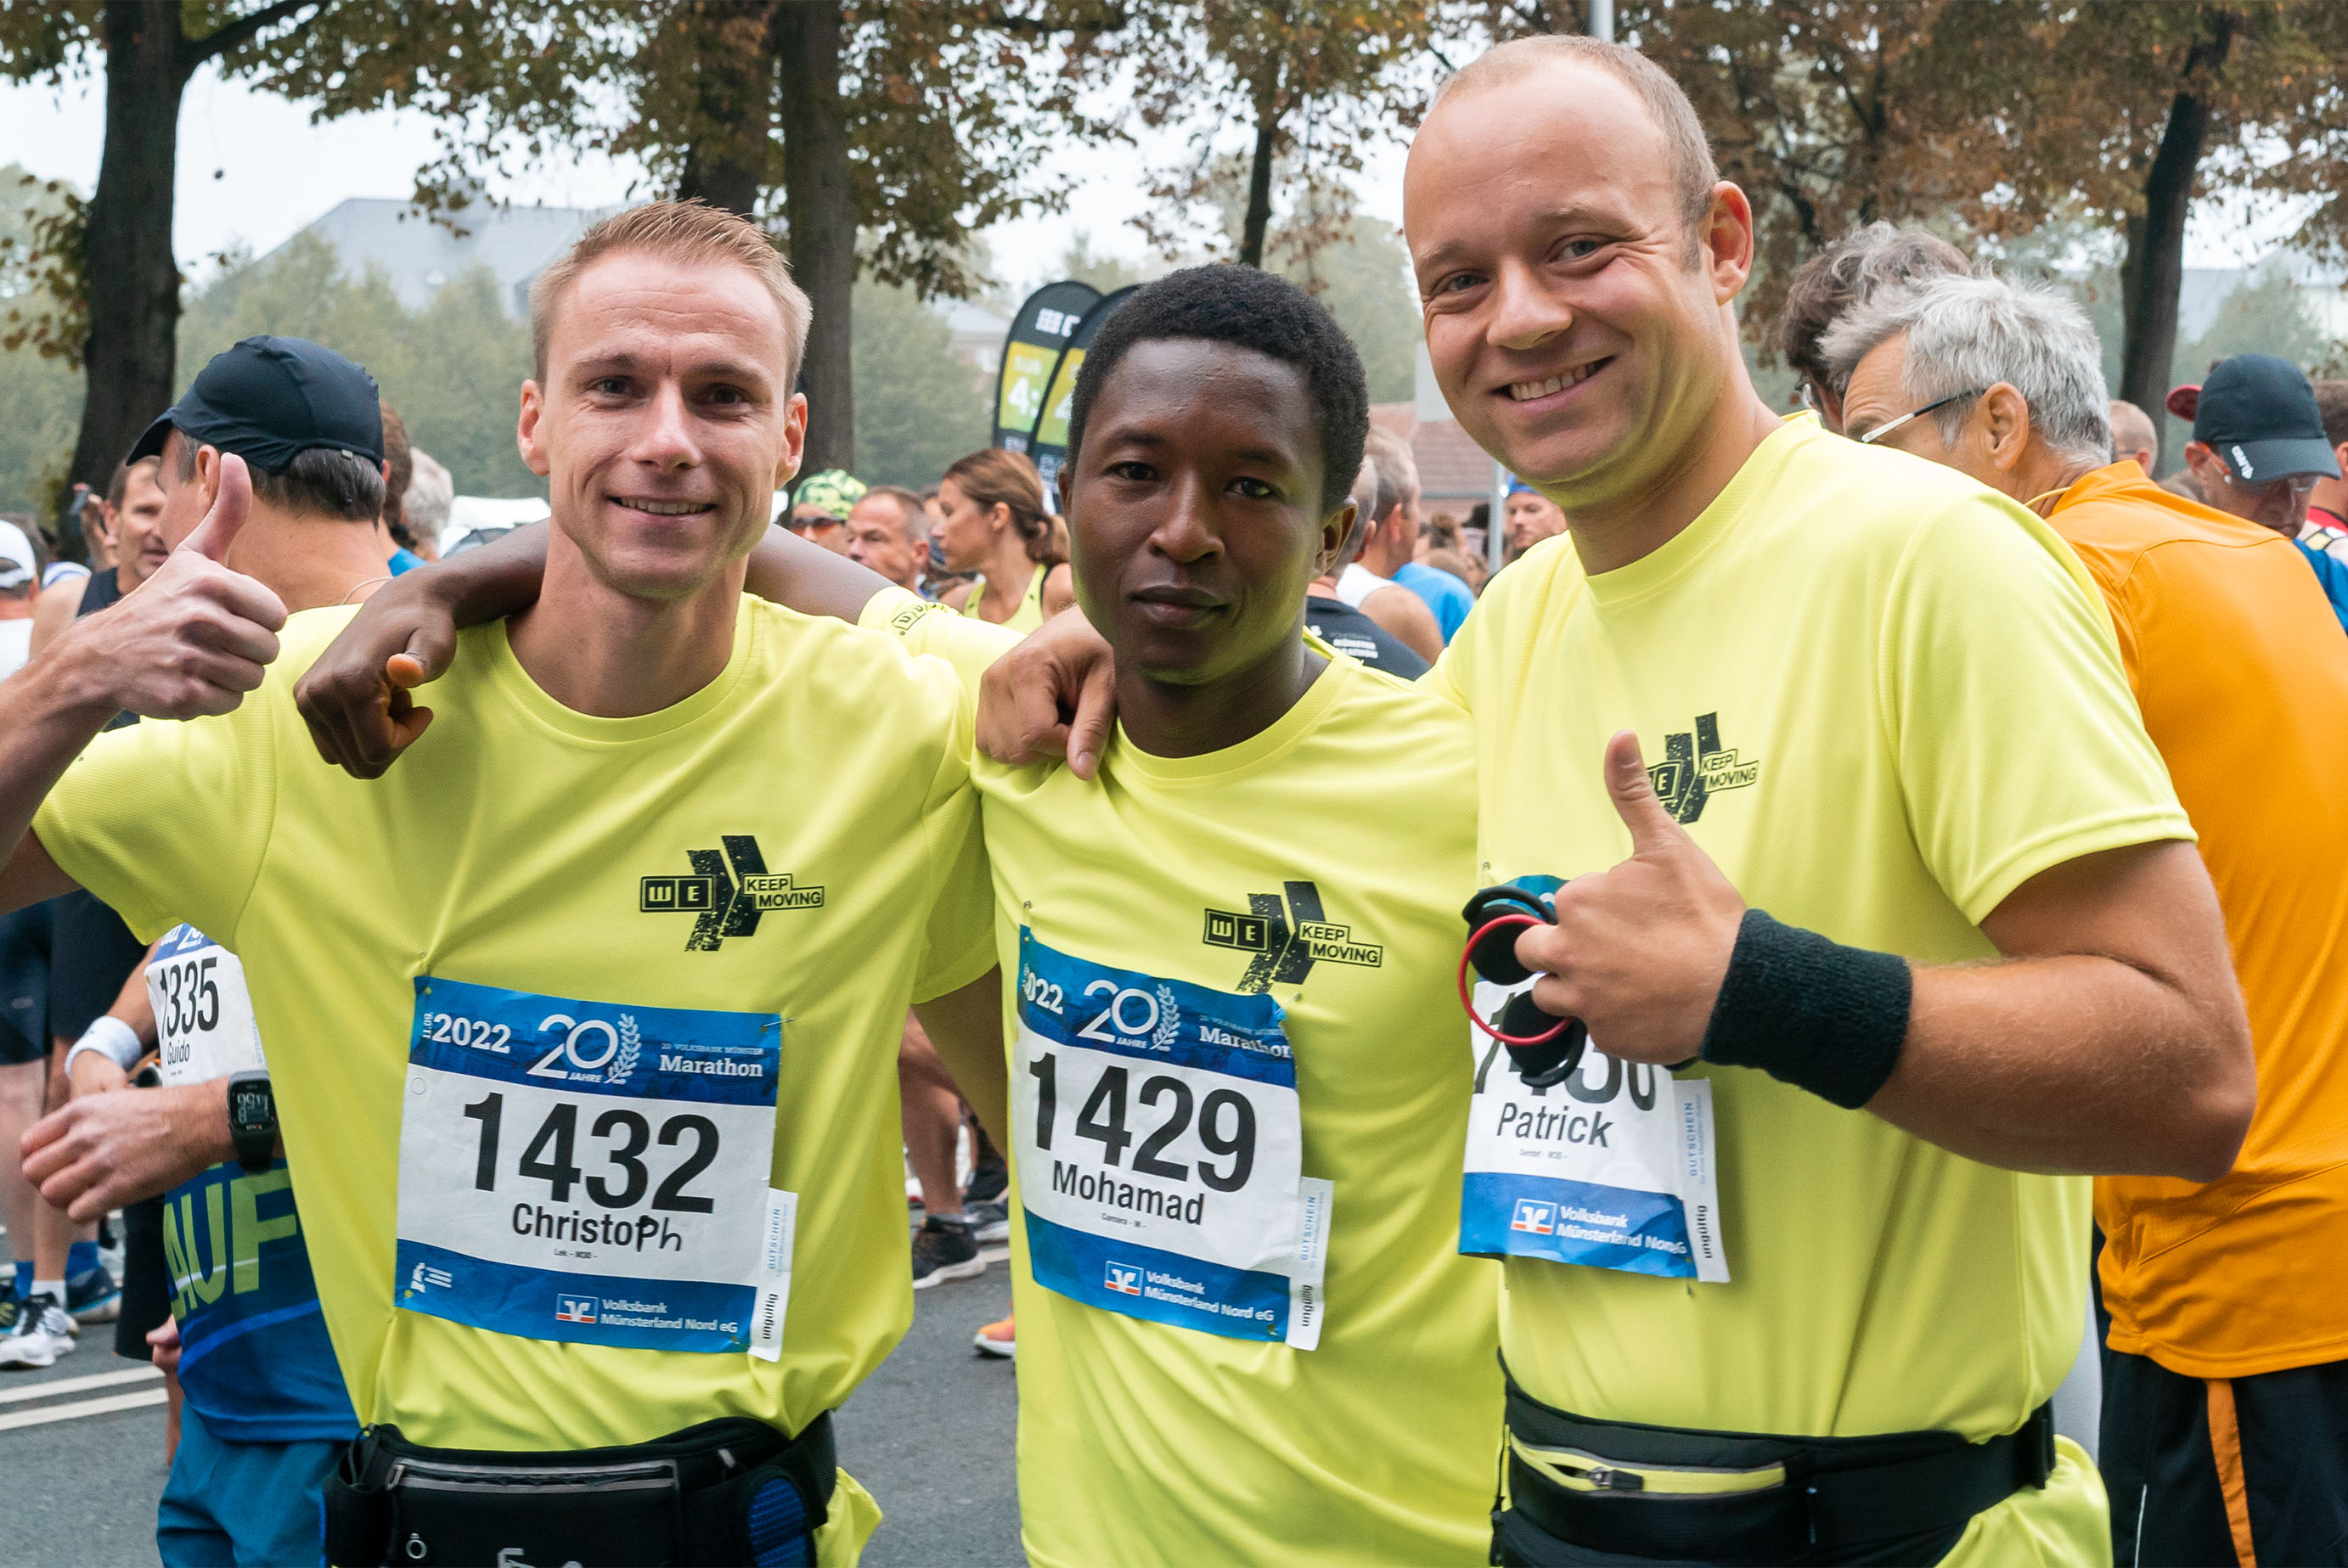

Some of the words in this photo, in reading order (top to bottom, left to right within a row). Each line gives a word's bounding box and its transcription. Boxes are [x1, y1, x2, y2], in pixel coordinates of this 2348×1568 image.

[1703, 755, 1733, 771] KEEP
[1709, 767, 1757, 788] MOVING
[747, 878, 788, 891] KEEP
[759, 891, 821, 907] MOVING
[1302, 925, 1345, 941] KEEP
[1312, 942, 1379, 963] MOVING
[160, 956, 219, 1039] 1335
[1076, 979, 1160, 1043] 20
[431, 1013, 511, 1054] 2022
[167, 1039, 190, 1065] Guido
[526, 1014, 619, 1080] 20
[568, 1072, 603, 1083] JAHRE
[659, 1054, 763, 1077] Marathon
[1029, 1052, 1257, 1193] 1429
[1495, 1102, 1614, 1149] Patrick
[463, 1092, 720, 1214] 1432
[1053, 1160, 1205, 1226] Mohamad
[1560, 1206, 1629, 1228] Volksbank
[1557, 1223, 1642, 1247] Münsterland
[1696, 1205, 1713, 1259] ungültig
[1146, 1270, 1205, 1295] Volksbank
[601, 1299, 668, 1314] Volksbank
[762, 1293, 780, 1340] ungültig
[1144, 1286, 1219, 1313] Münsterland
[1221, 1304, 1253, 1319] Nord
[1255, 1310, 1275, 1322] eG
[600, 1313, 683, 1329] Münsterland
[684, 1319, 718, 1331] Nord
[719, 1322, 739, 1334] eG
